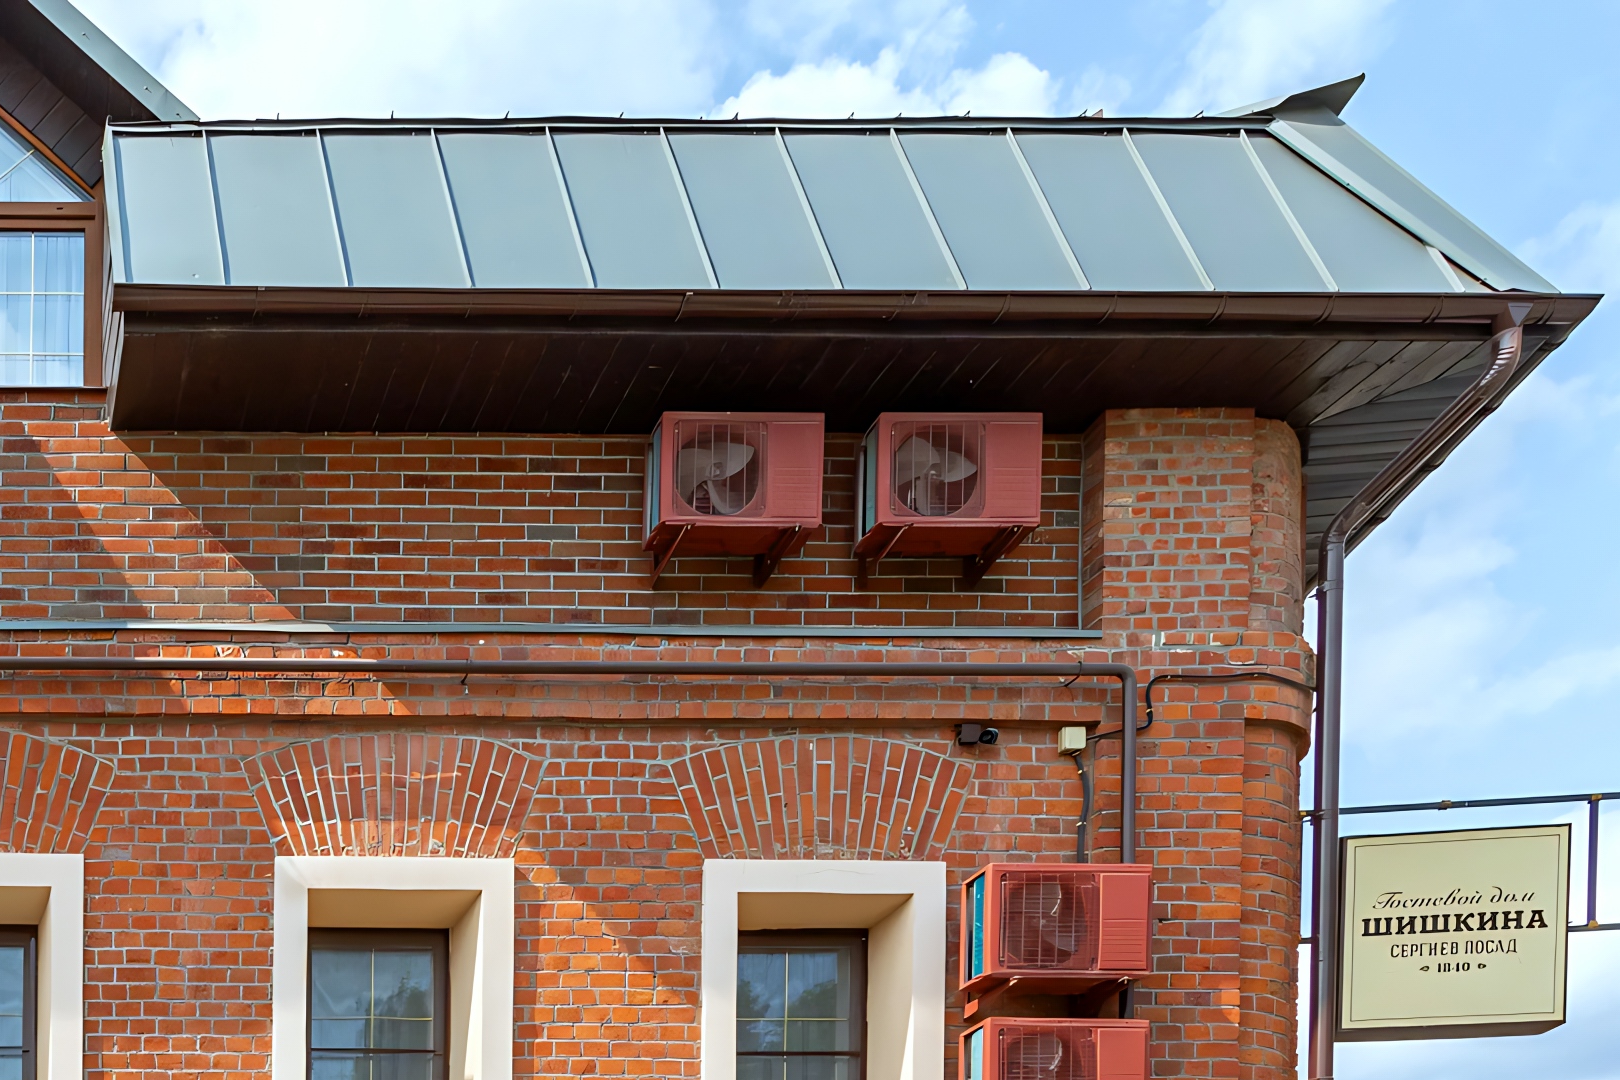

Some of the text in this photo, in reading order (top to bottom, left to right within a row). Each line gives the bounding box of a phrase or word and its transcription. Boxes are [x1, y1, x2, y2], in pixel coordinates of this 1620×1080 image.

[1373, 886, 1535, 909] Гостевой дом
[1361, 909, 1548, 937] ШИШКИНА
[1390, 938, 1518, 958] СЕРГИЕВ ПОСАД
